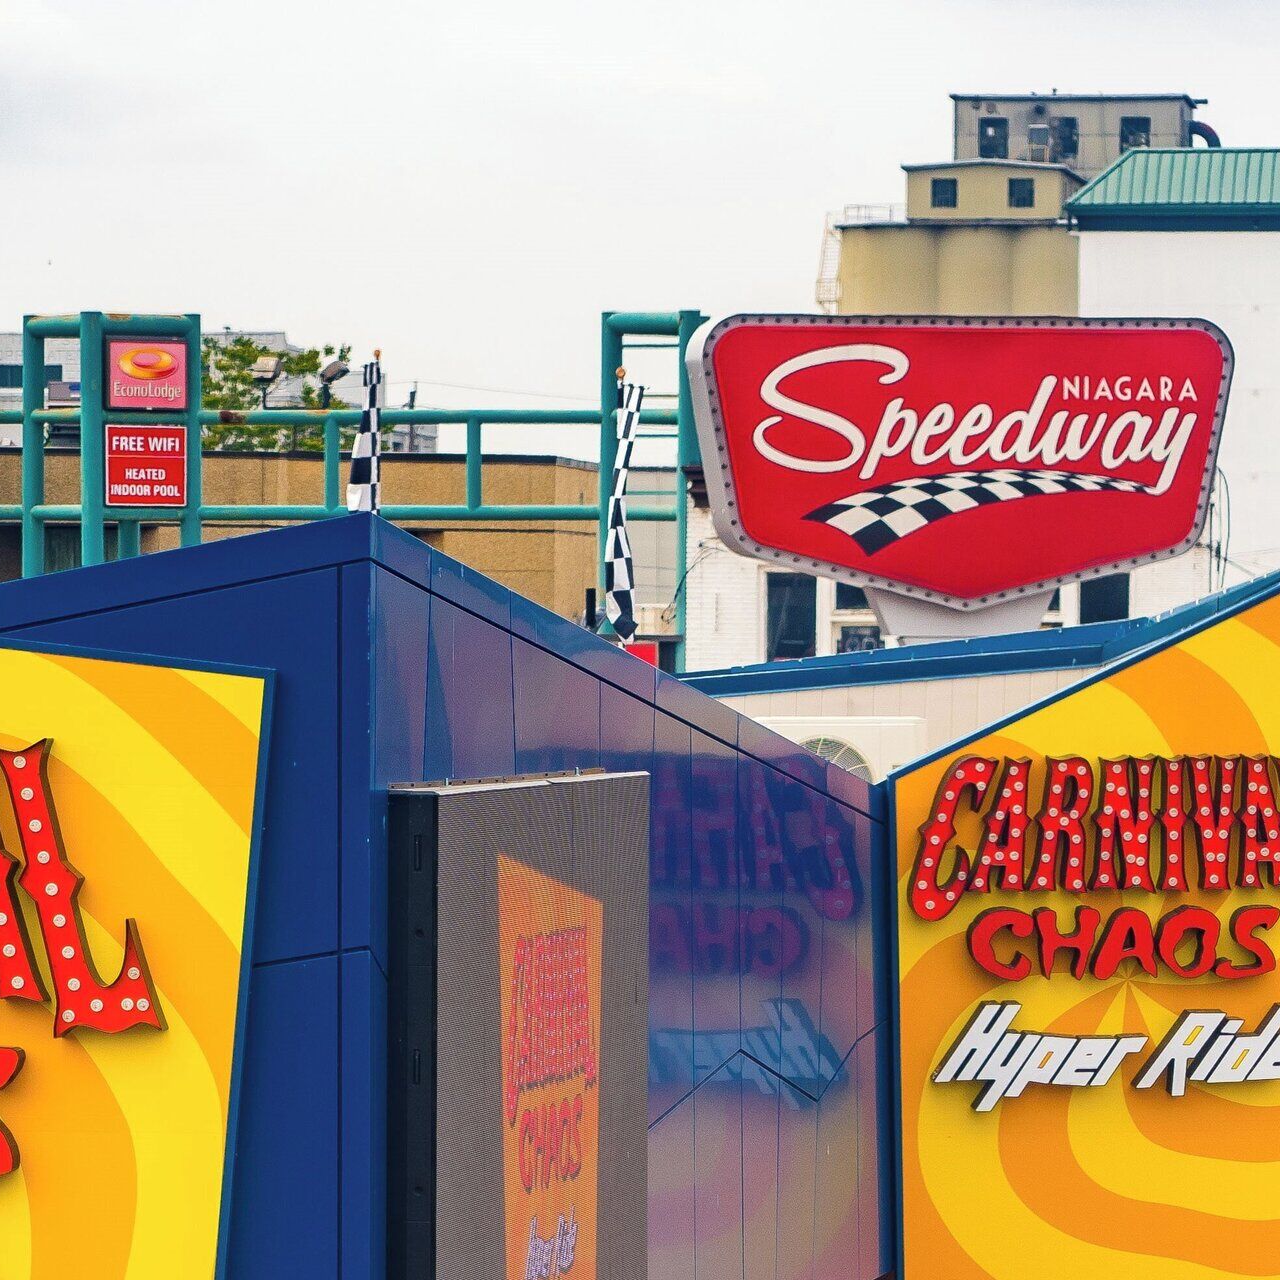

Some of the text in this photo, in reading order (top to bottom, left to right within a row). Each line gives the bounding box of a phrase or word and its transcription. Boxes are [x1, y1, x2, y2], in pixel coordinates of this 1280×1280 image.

[113, 381, 182, 401] EconoLodge
[1063, 375, 1198, 402] NIAGARA
[752, 343, 1198, 497] Speedway
[112, 436, 181, 452] FREE WIFI
[125, 468, 167, 481] HEATED
[110, 484, 181, 497] INDOOR POOL
[966, 904, 1280, 981] CHAOS
[931, 999, 1149, 1112] Hyper
[519, 1092, 583, 1194] CHAOS
